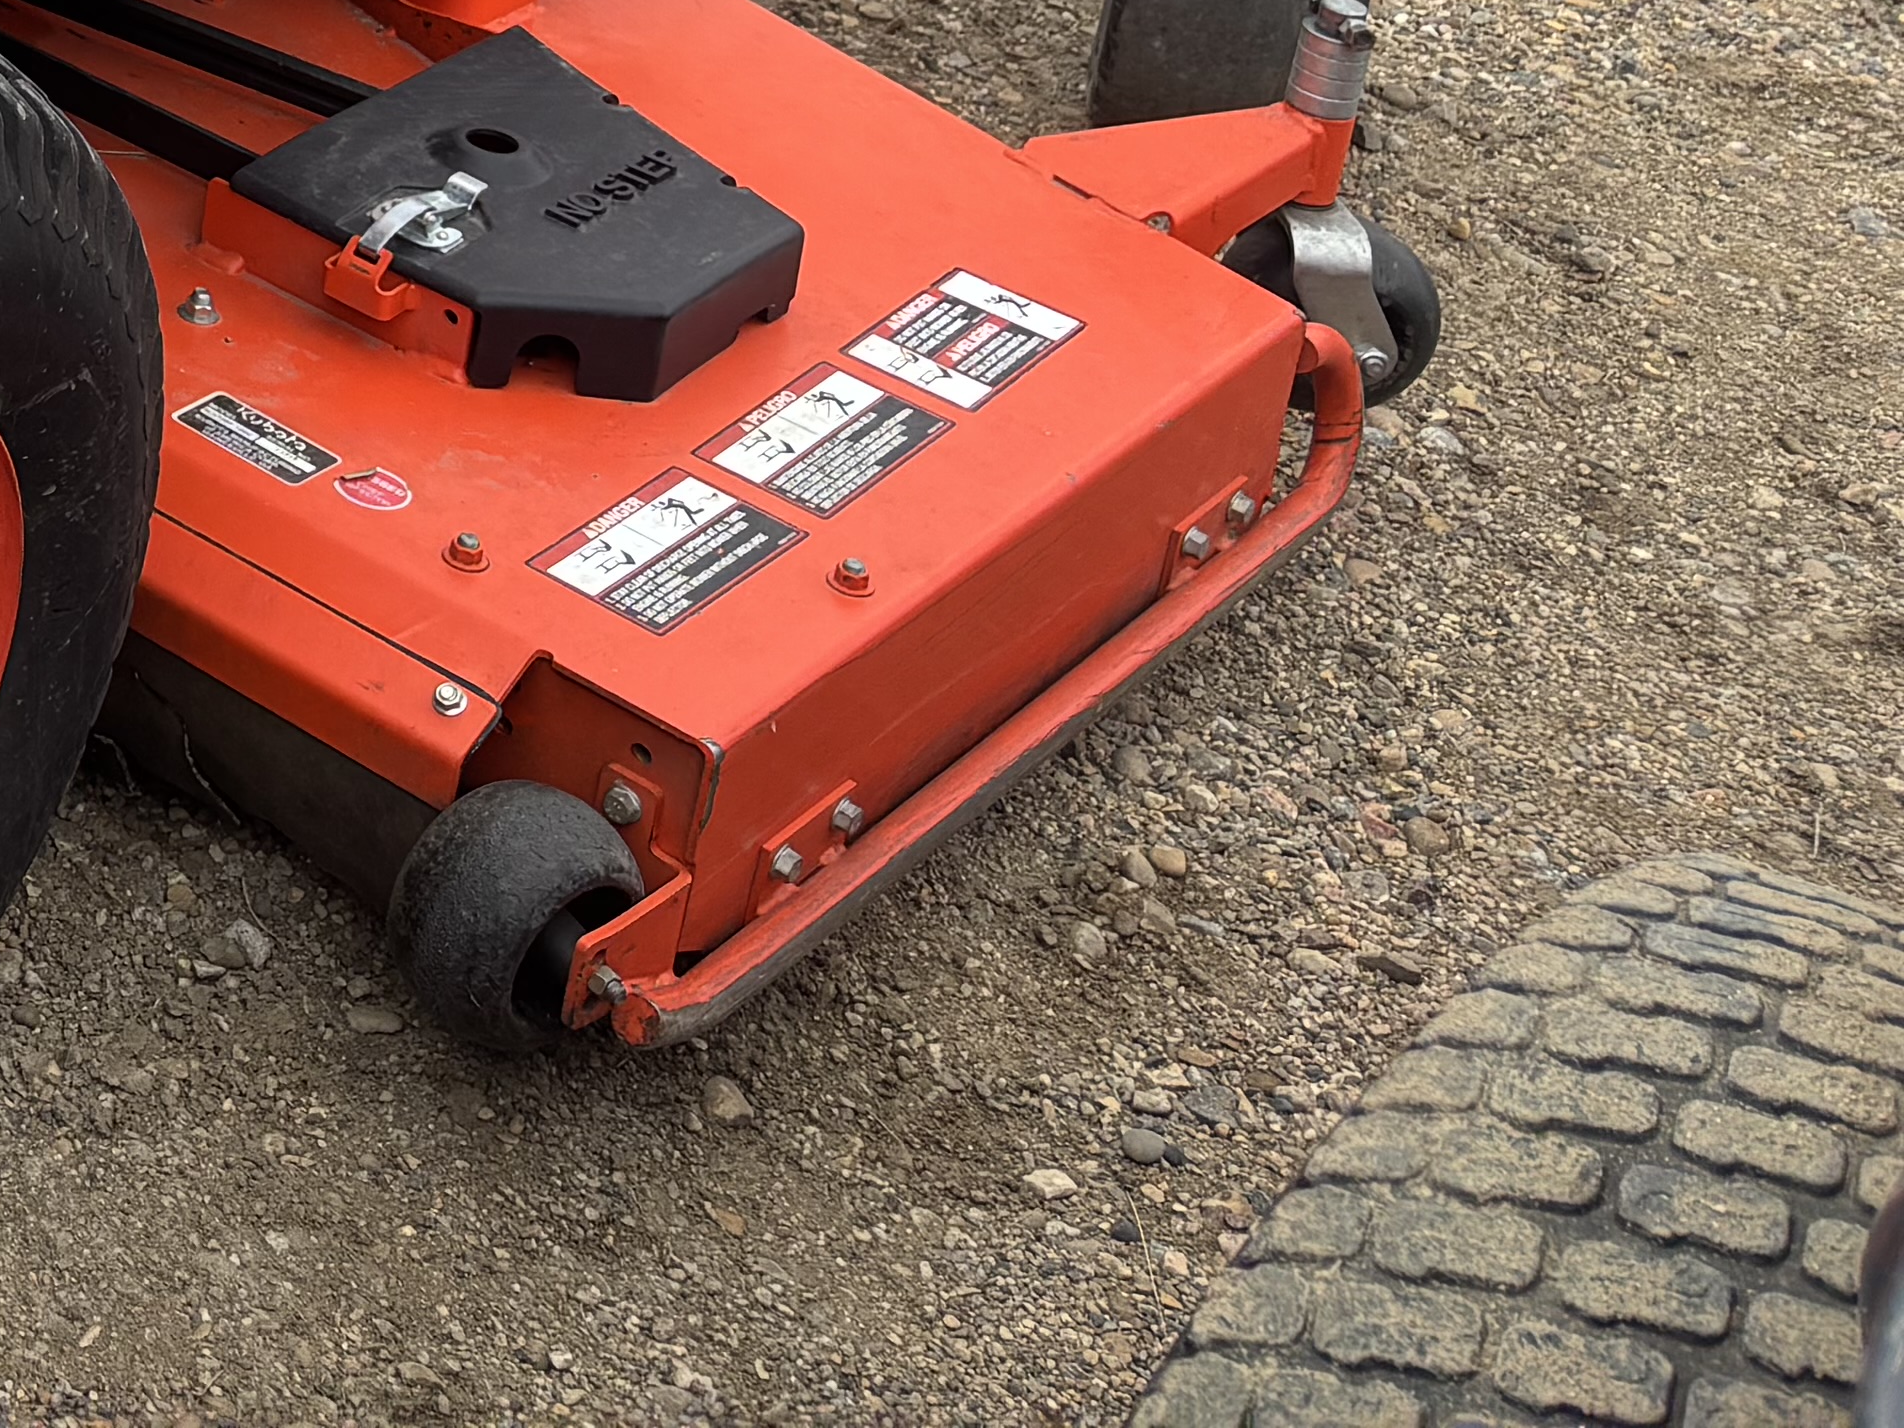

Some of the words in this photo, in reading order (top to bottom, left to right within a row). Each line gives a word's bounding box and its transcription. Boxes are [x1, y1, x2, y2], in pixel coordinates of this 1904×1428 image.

[544, 193, 607, 229] NO
[594, 150, 677, 201] STEP
[897, 293, 939, 329] DANGER
[958, 322, 1001, 358] PELIGRO
[237, 405, 307, 451] Kubota
[750, 391, 798, 428] PELIGRO
[592, 496, 646, 537] DANGER
